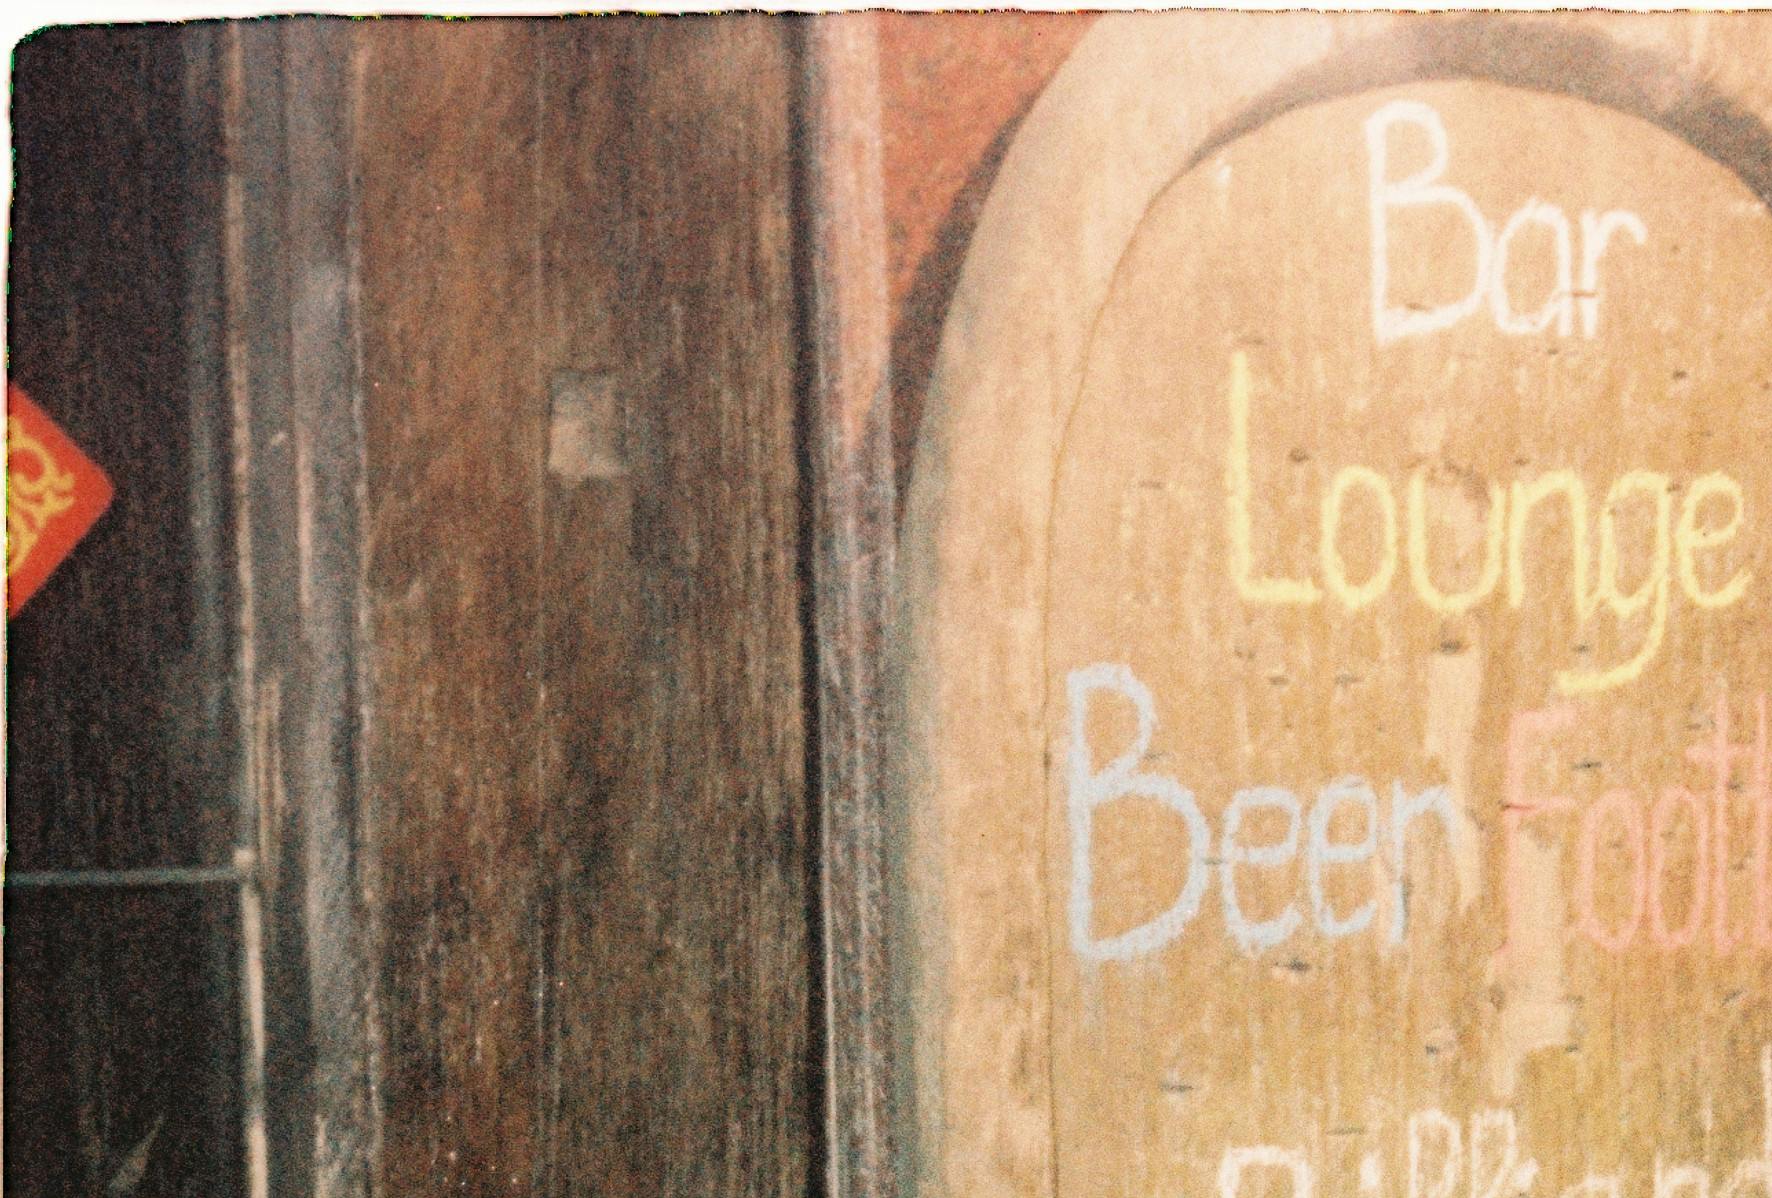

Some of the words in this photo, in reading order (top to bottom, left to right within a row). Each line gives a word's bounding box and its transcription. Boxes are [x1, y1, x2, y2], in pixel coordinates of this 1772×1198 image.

[1364, 101, 1648, 343] Bar
[1226, 351, 1753, 696] Lounge
[1065, 661, 1463, 962] Beer
